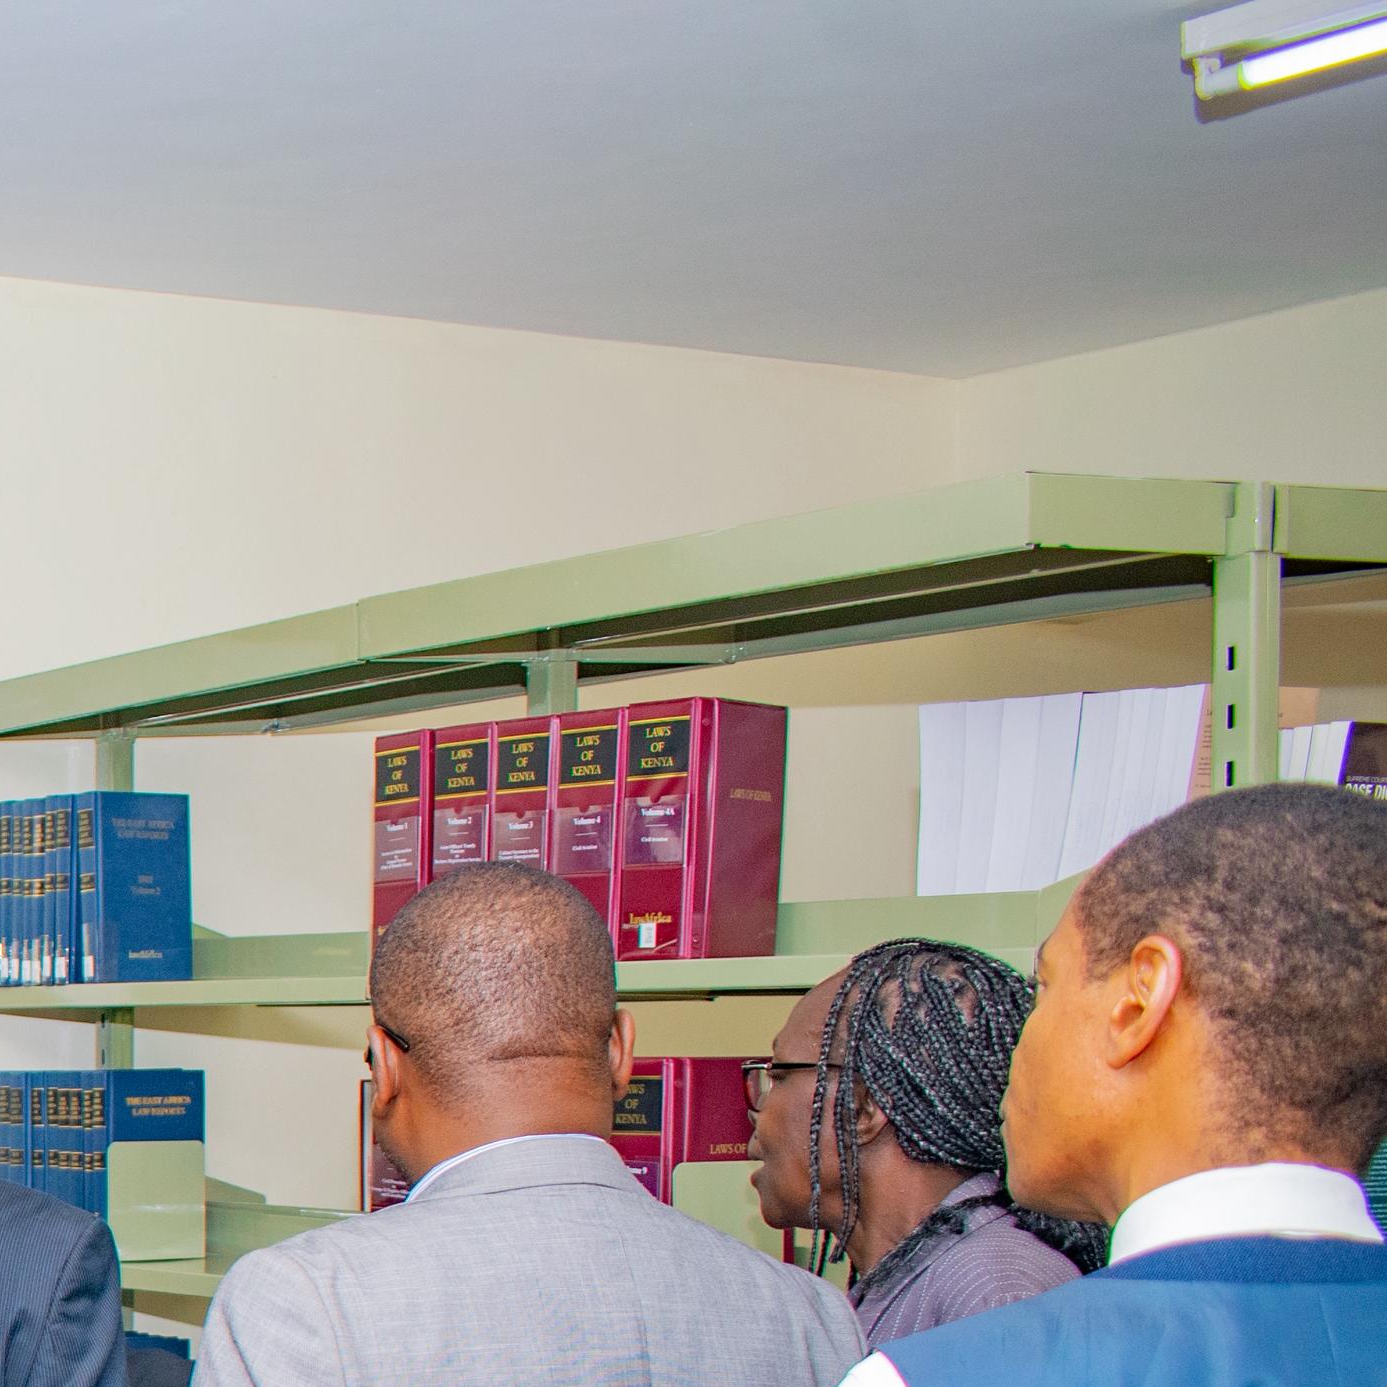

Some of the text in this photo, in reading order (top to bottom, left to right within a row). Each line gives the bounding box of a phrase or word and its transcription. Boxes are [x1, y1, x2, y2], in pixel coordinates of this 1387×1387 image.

[645, 726, 672, 739] LAWS
[574, 735, 601, 747] LAWS
[512, 742, 535, 754] LAWS
[650, 742, 665, 753] OF
[451, 748, 474, 760] LAWS
[580, 751, 594, 761] OF
[388, 756, 407, 767] LAWS
[516, 757, 529, 767] OF
[640, 756, 674, 769] KENYA
[456, 762, 468, 773] OF
[571, 764, 602, 777] KENYA
[392, 770, 403, 781] OF
[508, 771, 536, 782] KENYA
[1346, 775, 1370, 783] SUPREME
[448, 776, 475, 788] KENYA
[385, 784, 409, 795] KENYA
[641, 808, 663, 817] Volume
[627, 1084, 645, 1094] AWS
[625, 1098, 638, 1109] OF
[615, 1113, 647, 1125] KENYA
[710, 1143, 747, 1154] LAWS OF
